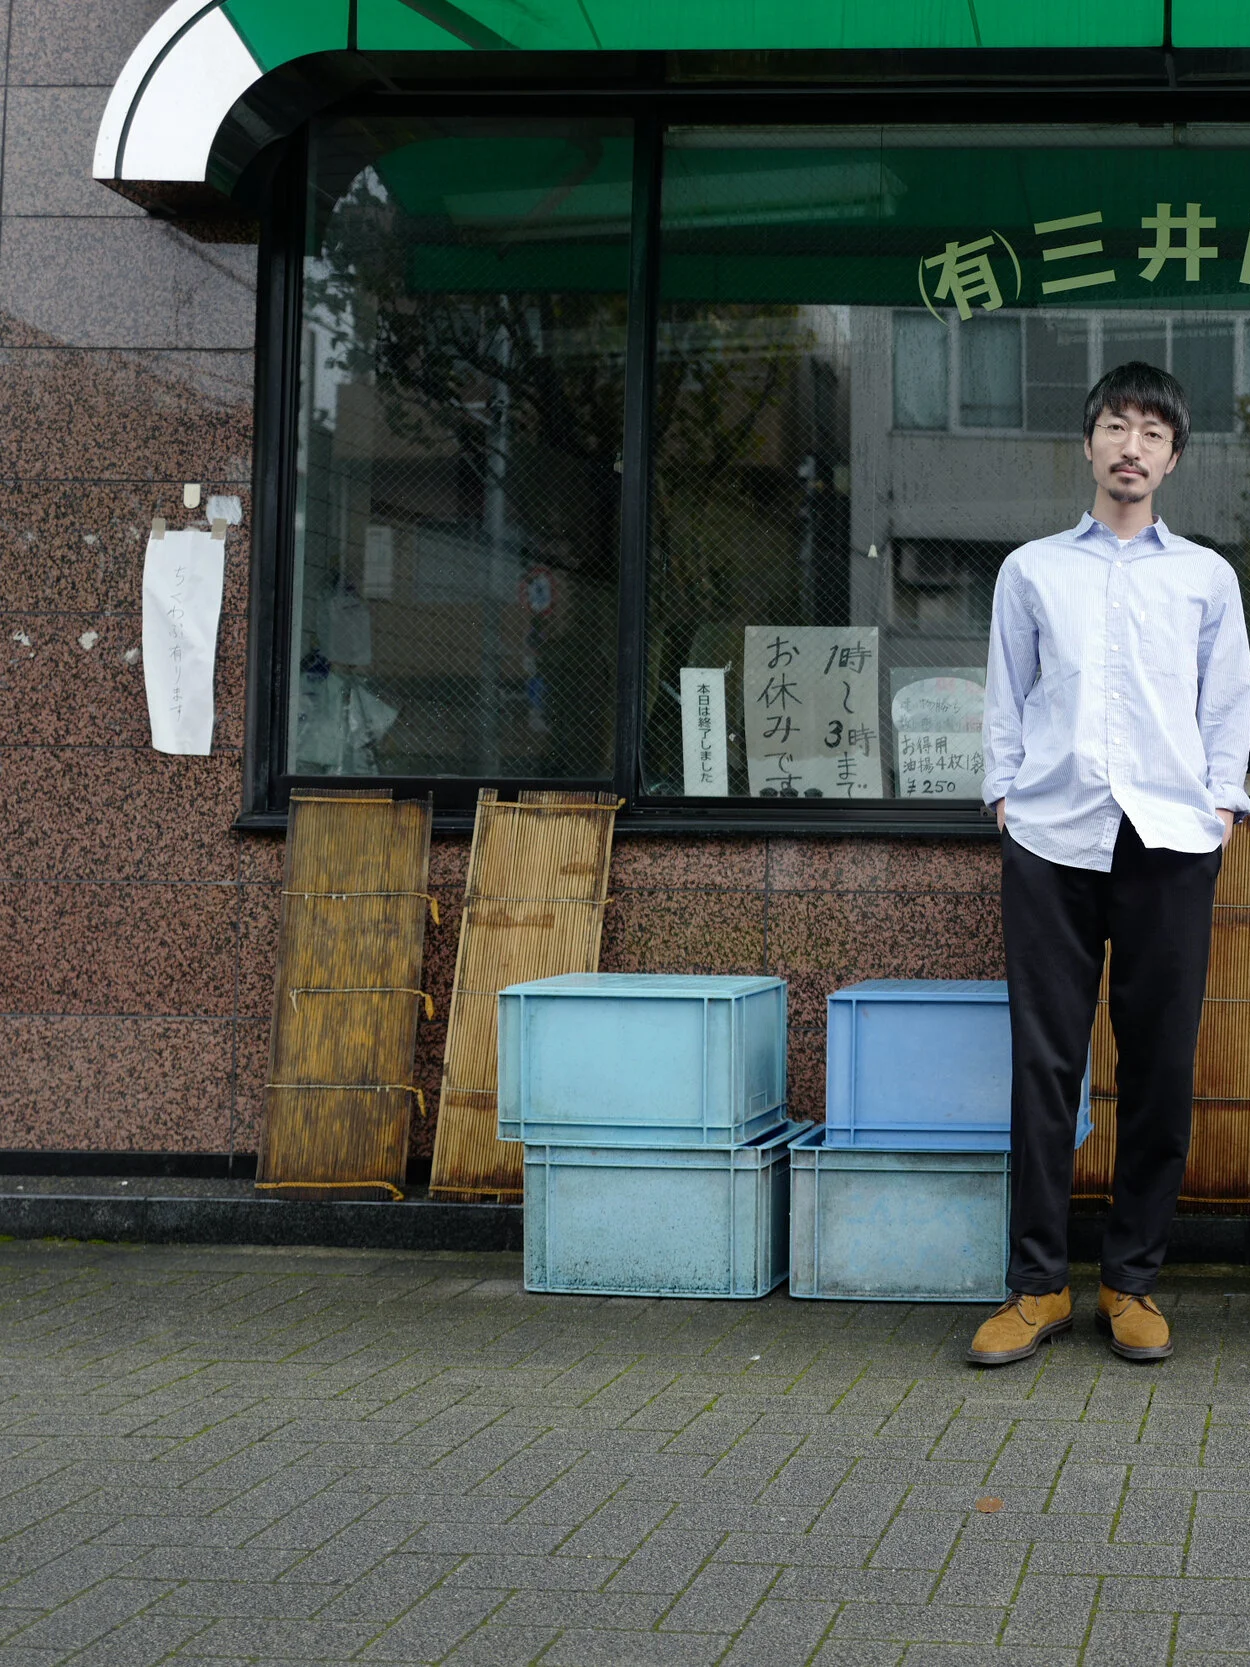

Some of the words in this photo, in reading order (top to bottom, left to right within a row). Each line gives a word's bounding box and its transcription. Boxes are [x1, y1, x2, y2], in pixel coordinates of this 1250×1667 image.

[167, 566, 186, 722] ちくわぶ有ります
[697, 683, 713, 782] 本日は終了しました
[757, 636, 802, 790] お休みです
[902, 735, 948, 756] お得用
